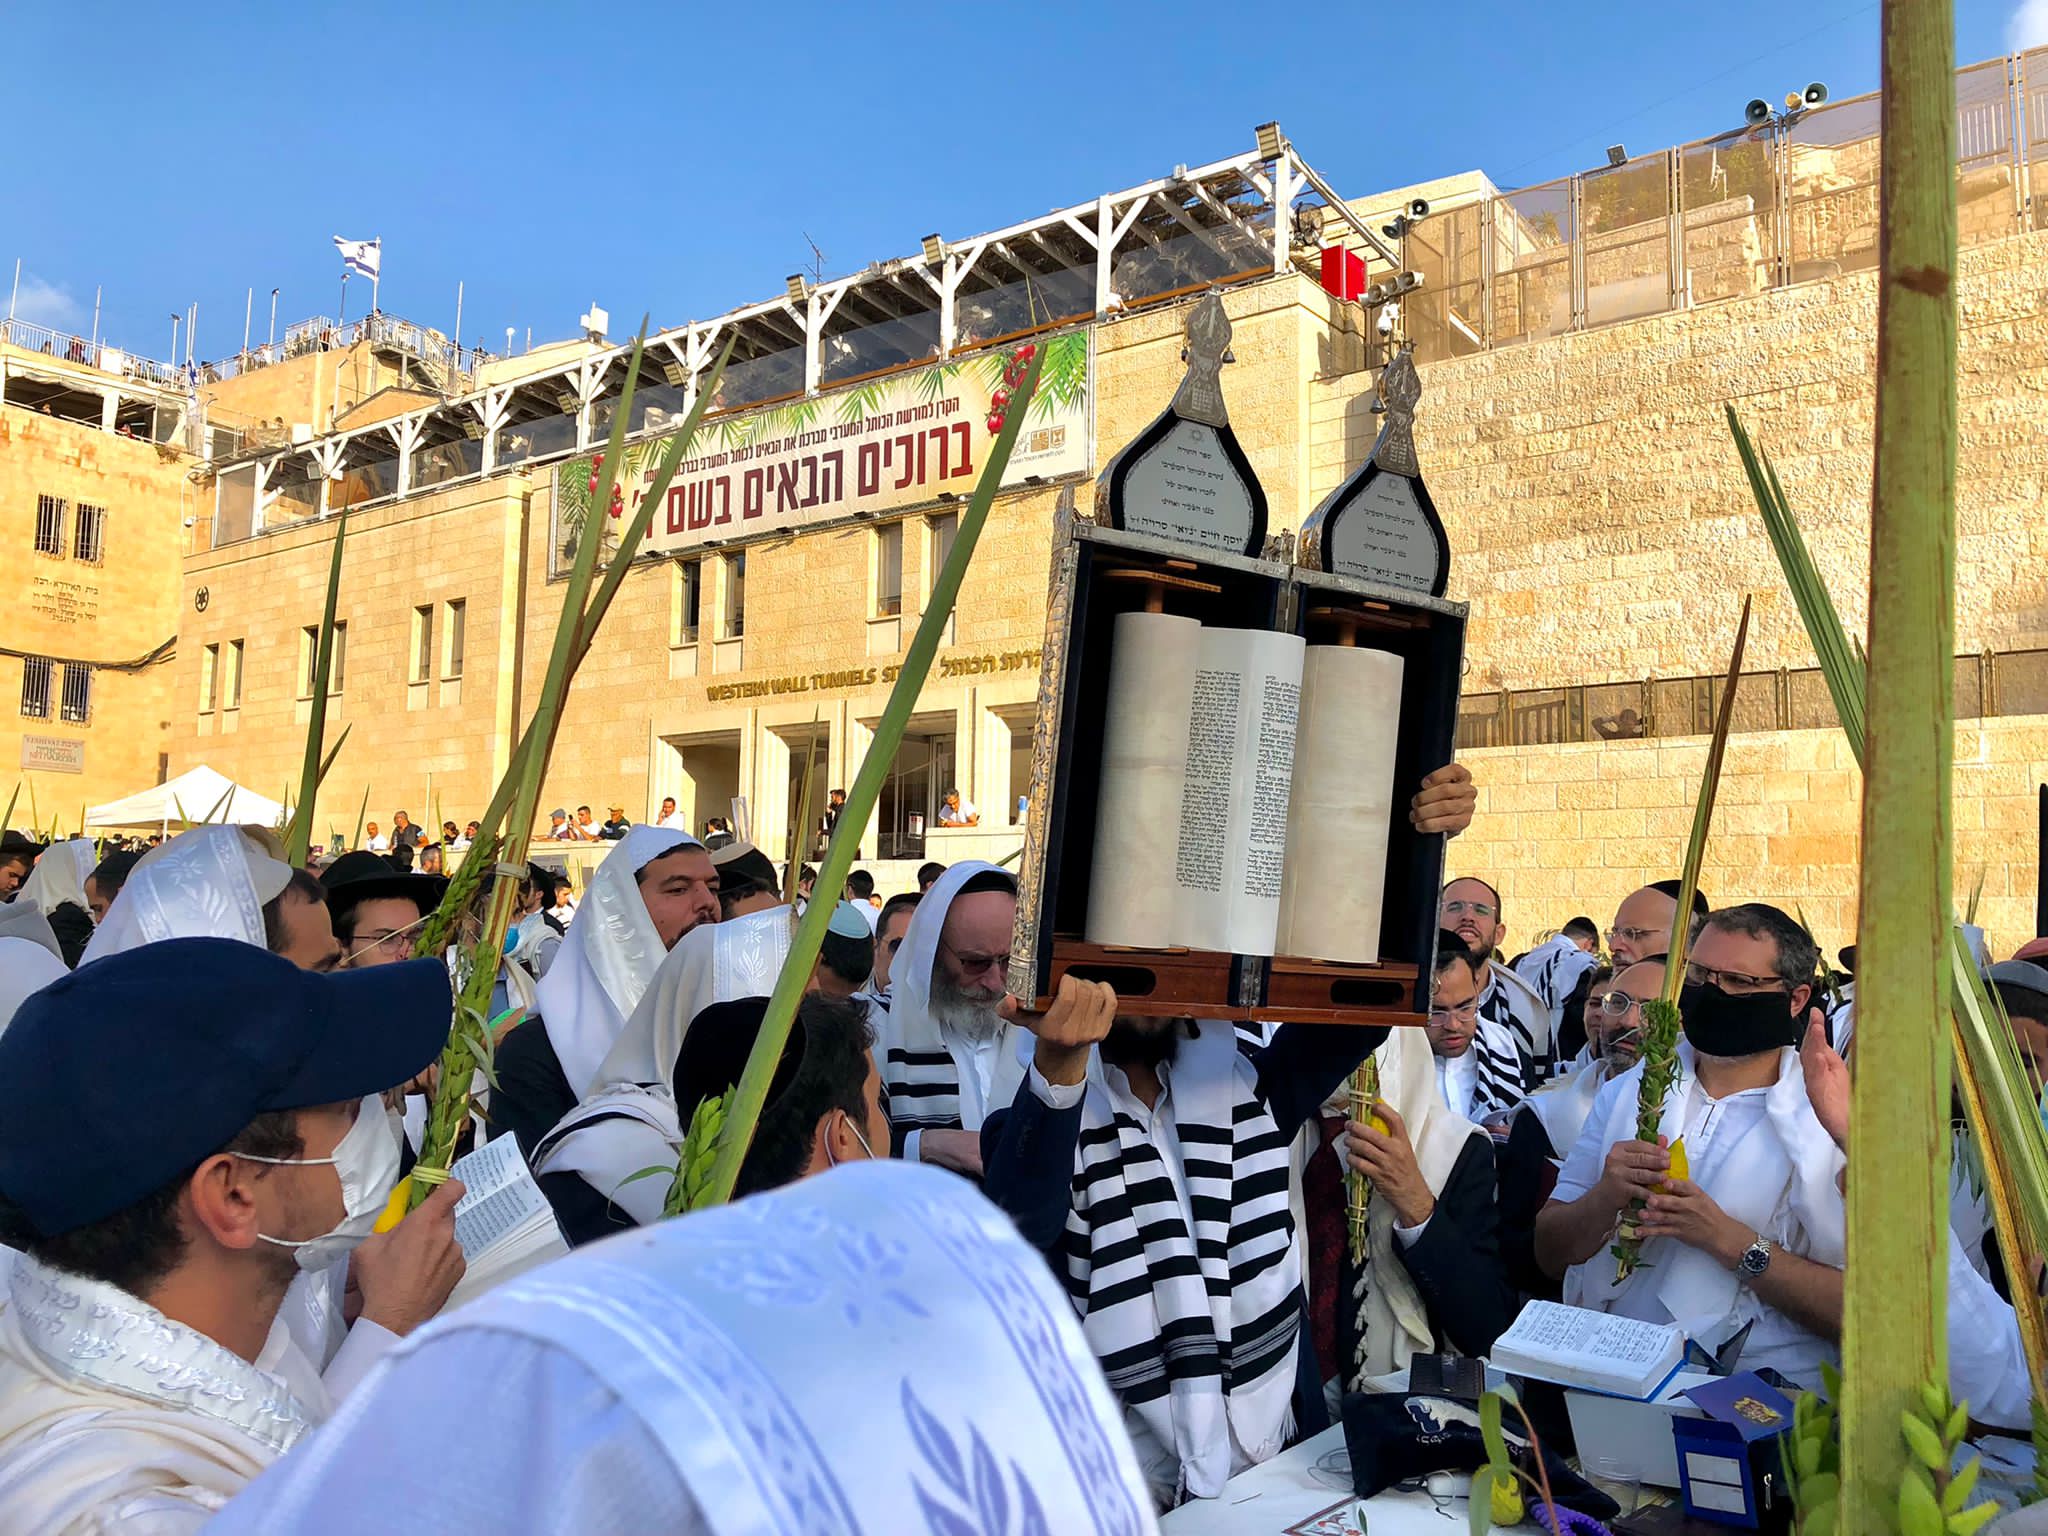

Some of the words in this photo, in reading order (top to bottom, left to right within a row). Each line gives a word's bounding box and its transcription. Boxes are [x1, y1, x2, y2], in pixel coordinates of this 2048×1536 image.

[895, 400, 934, 426] למורשת
[936, 397, 960, 420] הקרן
[830, 420, 863, 441] המערבי
[865, 410, 893, 433] הכותל
[756, 440, 781, 458] הבאים
[784, 436, 797, 451] את
[799, 429, 827, 448] מברכת
[700, 452, 728, 470] המערבי
[730, 444, 753, 464] לכותל
[857, 420, 974, 497] ברוכים
[743, 449, 844, 520] הבאים
[666, 475, 732, 535] בשם
[1200, 529, 1221, 540] חיים
[940, 654, 996, 679] הכותל
[706, 680, 769, 701] WESTERN
[770, 675, 809, 694] WALL
[810, 667, 877, 690] TUNNELS
